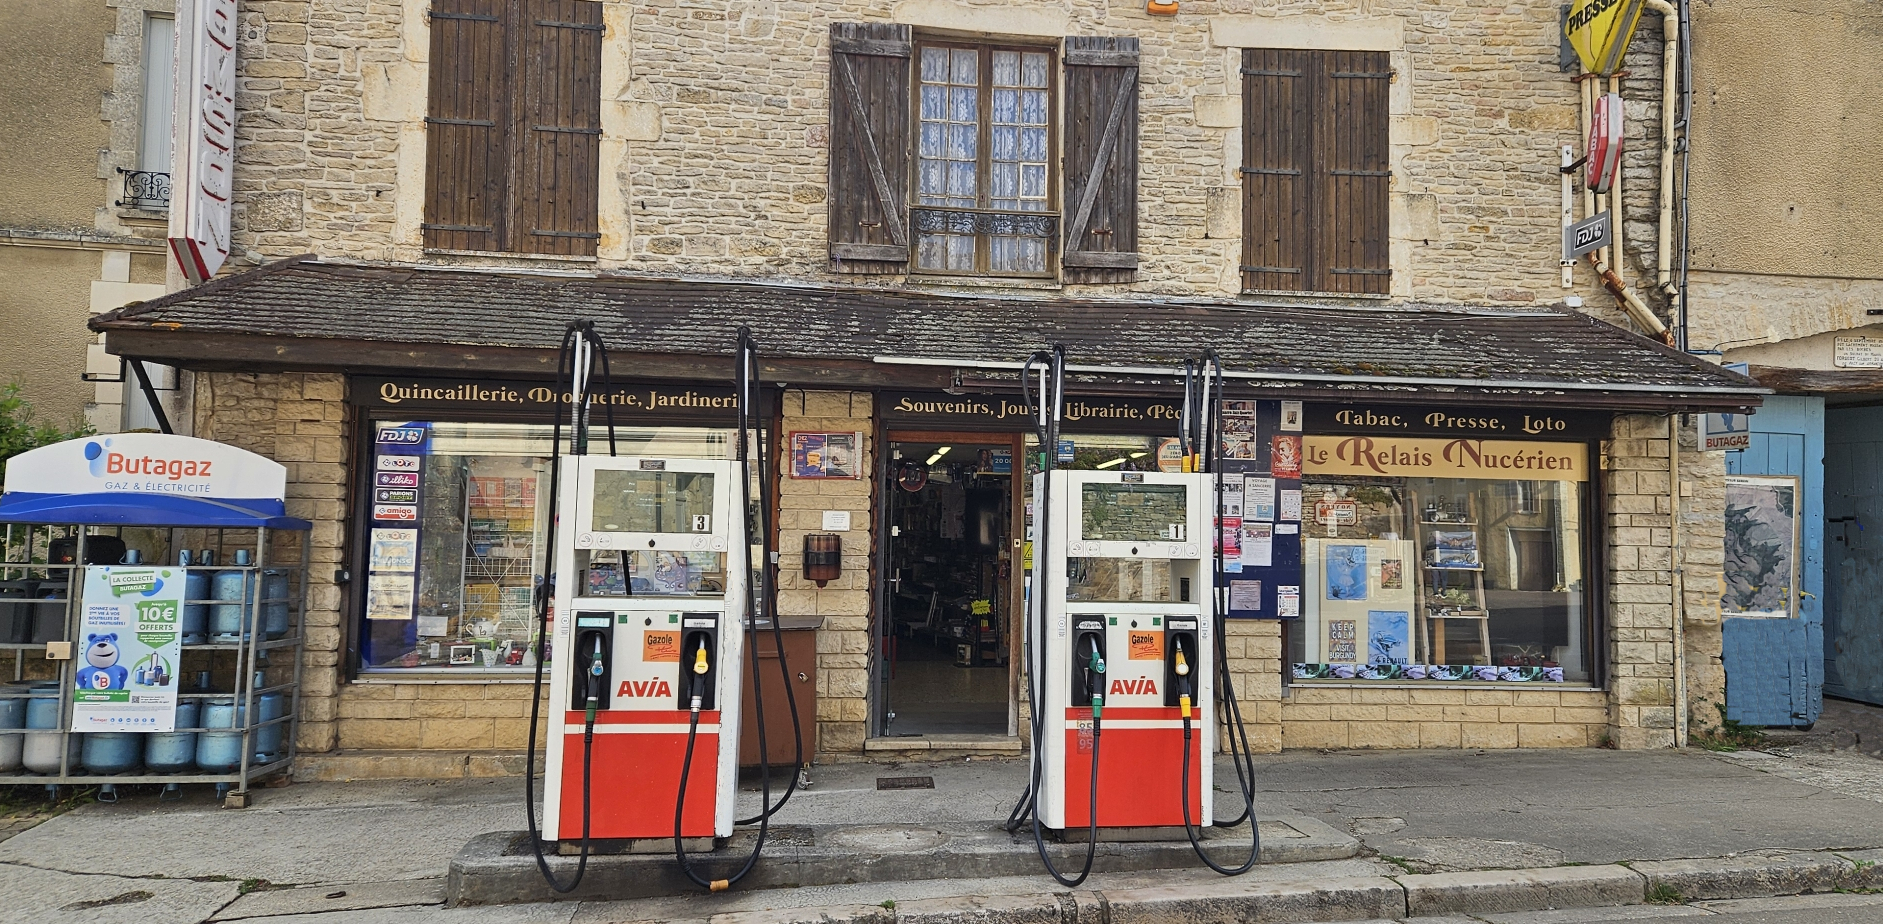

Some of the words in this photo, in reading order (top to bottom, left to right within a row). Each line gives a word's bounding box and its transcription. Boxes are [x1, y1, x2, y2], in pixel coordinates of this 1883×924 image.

[1588, 114, 1600, 175] TABAC
[1577, 227, 1594, 245] FDJ
[380, 382, 524, 404] Quincaillerie,
[646, 390, 738, 410] Jardineri
[894, 397, 994, 416] Souvenirs,
[1064, 402, 1144, 420] Librairie,
[1336, 410, 1408, 428] Tabac,
[1425, 412, 1506, 432] Presse,
[1522, 415, 1566, 434] Loto
[380, 431, 405, 440] FDJ
[1706, 435, 1749, 448] BUTAGAZ
[1307, 445, 1328, 466] Le
[1336, 436, 1432, 474] Relais
[1442, 439, 1574, 471] Nucérien
[107, 453, 212, 480] Butagaz
[389, 475, 414, 484] illiko
[146, 481, 210, 492] ÉLECTRICITÉ
[387, 507, 412, 518] amigo
[697, 516, 705, 529] 3
[1174, 525, 1178, 538] 1
[647, 634, 672, 645] Gazole
[1132, 634, 1154, 644] Gazole
[101, 677, 108, 687] B
